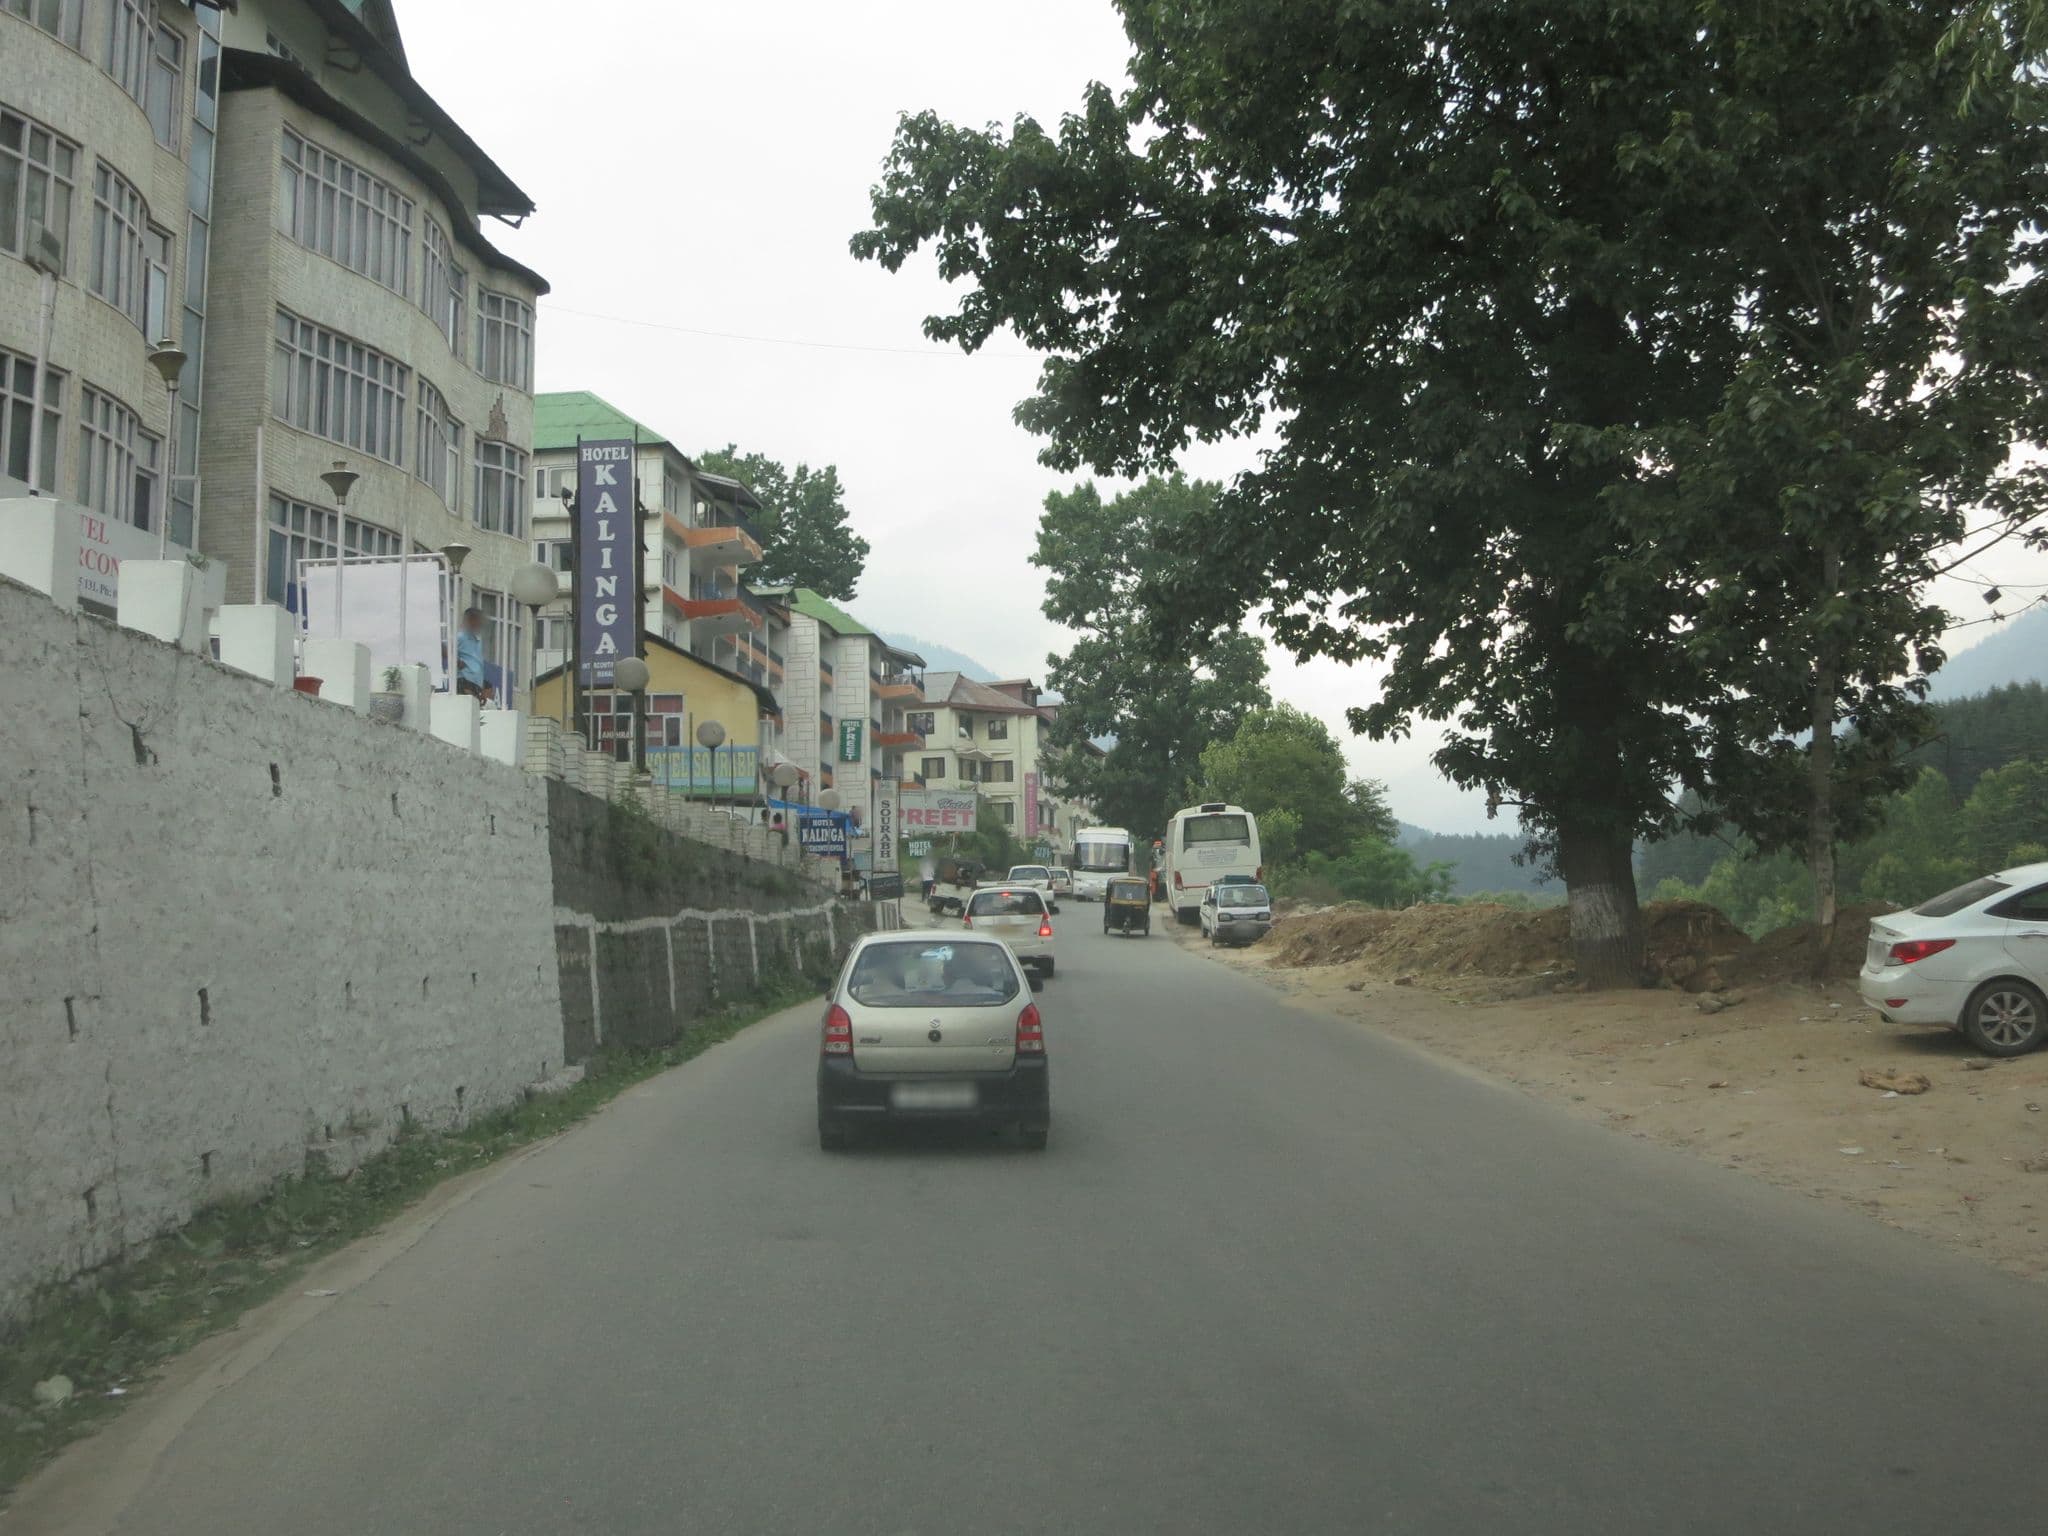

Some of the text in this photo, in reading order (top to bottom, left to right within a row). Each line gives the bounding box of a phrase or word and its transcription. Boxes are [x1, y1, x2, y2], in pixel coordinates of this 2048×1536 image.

[582, 446, 629, 462] HOTEL
[594, 464, 618, 655] KALINGA
[880, 800, 892, 858] SOURABH
[908, 841, 932, 849] HOTEL
